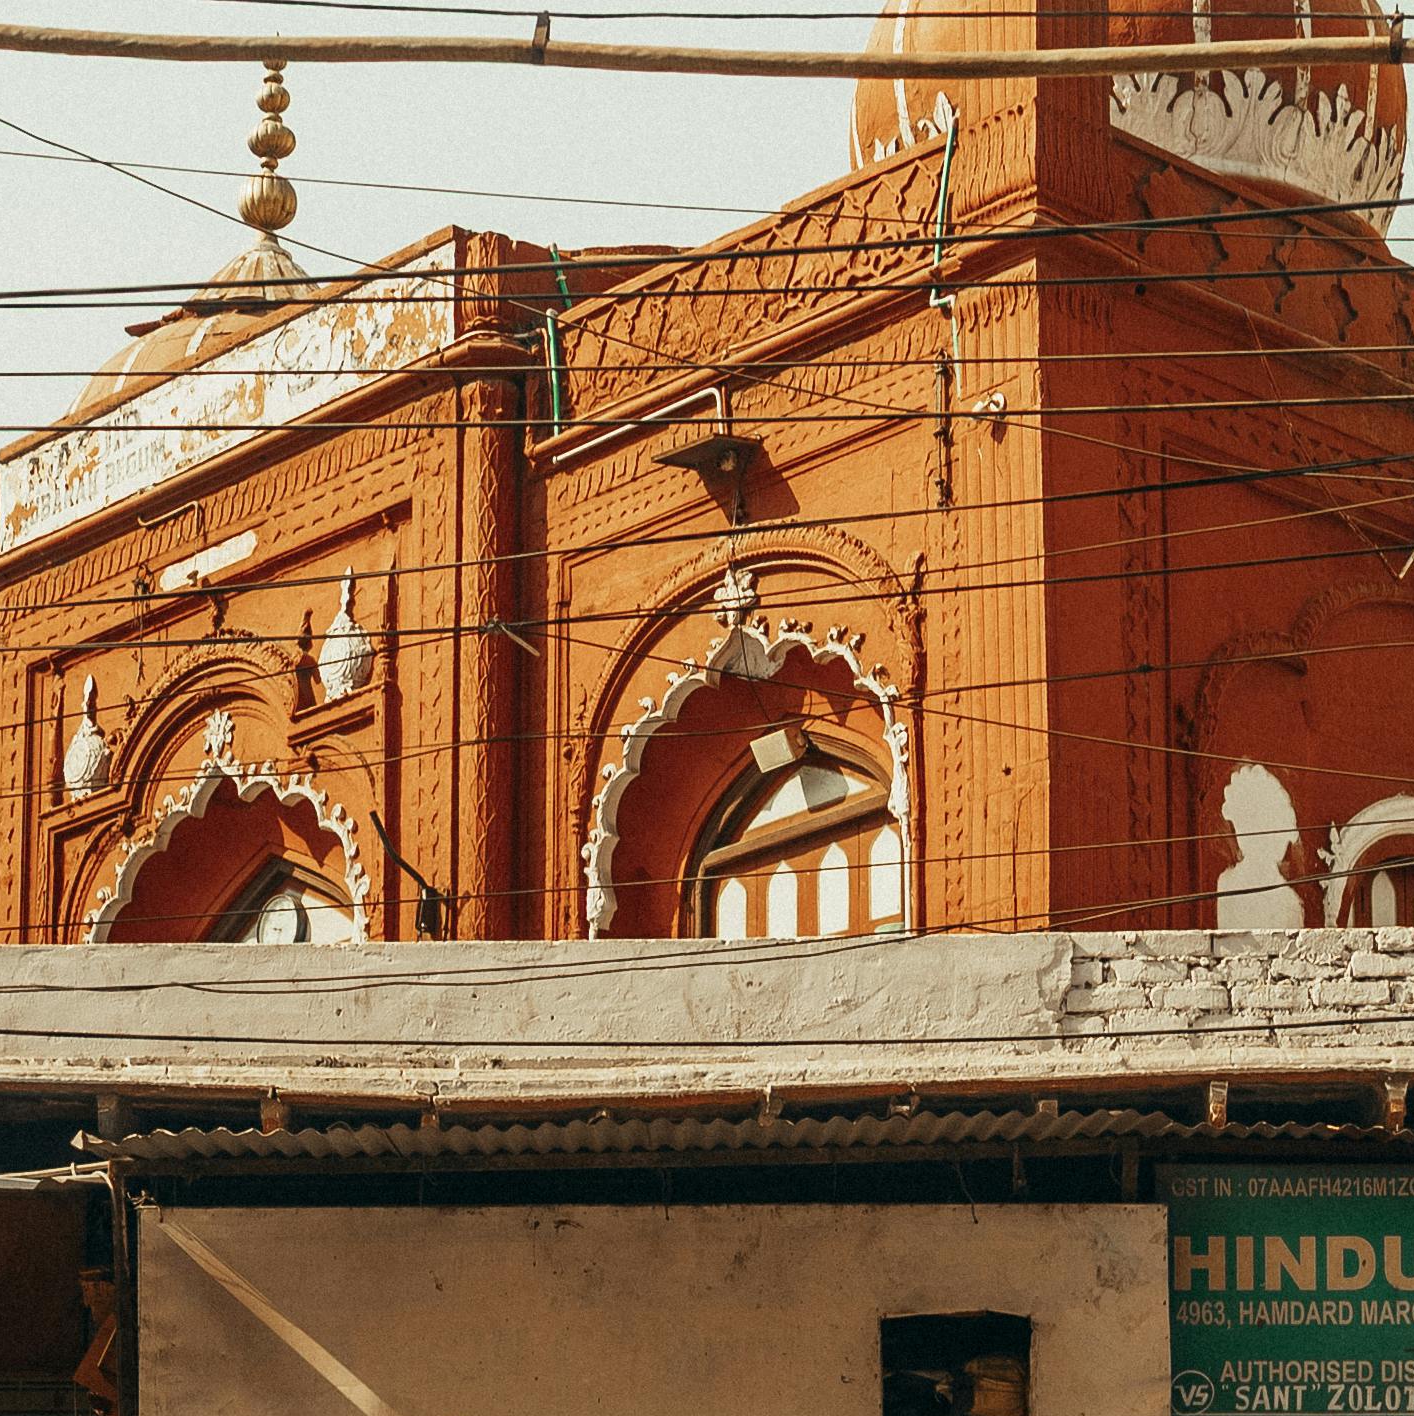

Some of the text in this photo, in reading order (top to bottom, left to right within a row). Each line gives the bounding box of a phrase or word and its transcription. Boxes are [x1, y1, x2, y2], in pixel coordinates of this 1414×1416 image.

[1214, 1177, 1232, 1197] IN
[1176, 1299, 1232, 1330] 4963,
[1239, 1300, 1354, 1326] HAMDARD
[1220, 1360, 1374, 1384] AUTHORISED
